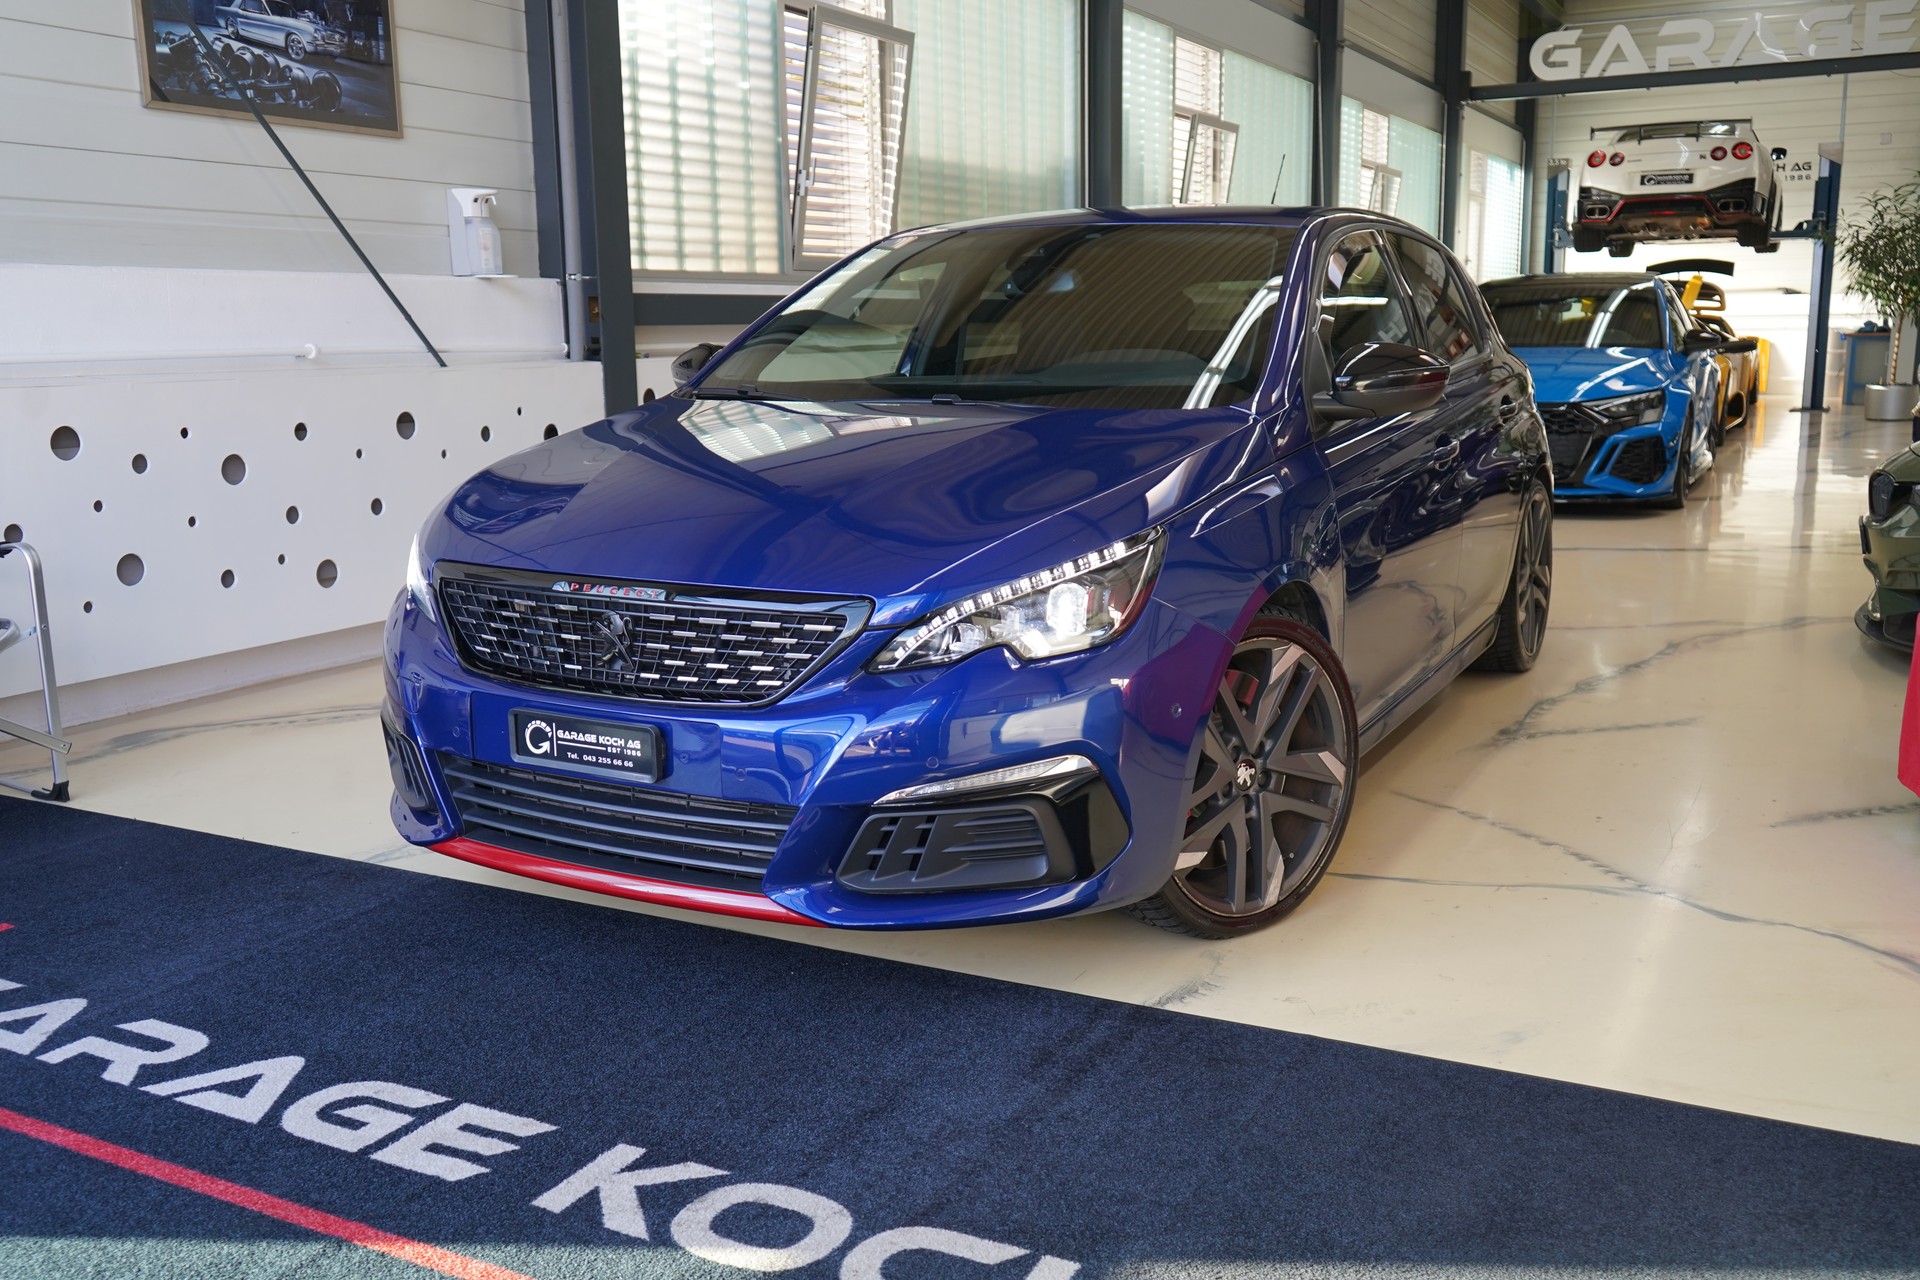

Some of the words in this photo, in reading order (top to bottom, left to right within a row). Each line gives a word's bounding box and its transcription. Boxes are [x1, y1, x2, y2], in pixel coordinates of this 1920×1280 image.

[1529, 0, 1920, 81] GARAGE
[1791, 162, 1812, 171] AG
[570, 582, 660, 600] PEUGEOT
[557, 730, 597, 743] GARAGE
[599, 735, 625, 747] KOCH
[626, 740, 641, 749] AG
[566, 752, 580, 760] Tel.
[583, 754, 596, 762] 043
[598, 756, 611, 764] 255
[613, 758, 622, 766] 66
[624, 759, 634, 768] 66
[623, 749, 642, 757] 1986
[0, 979, 560, 1181] ARAGE
[531, 1143, 1082, 1280] KOC
